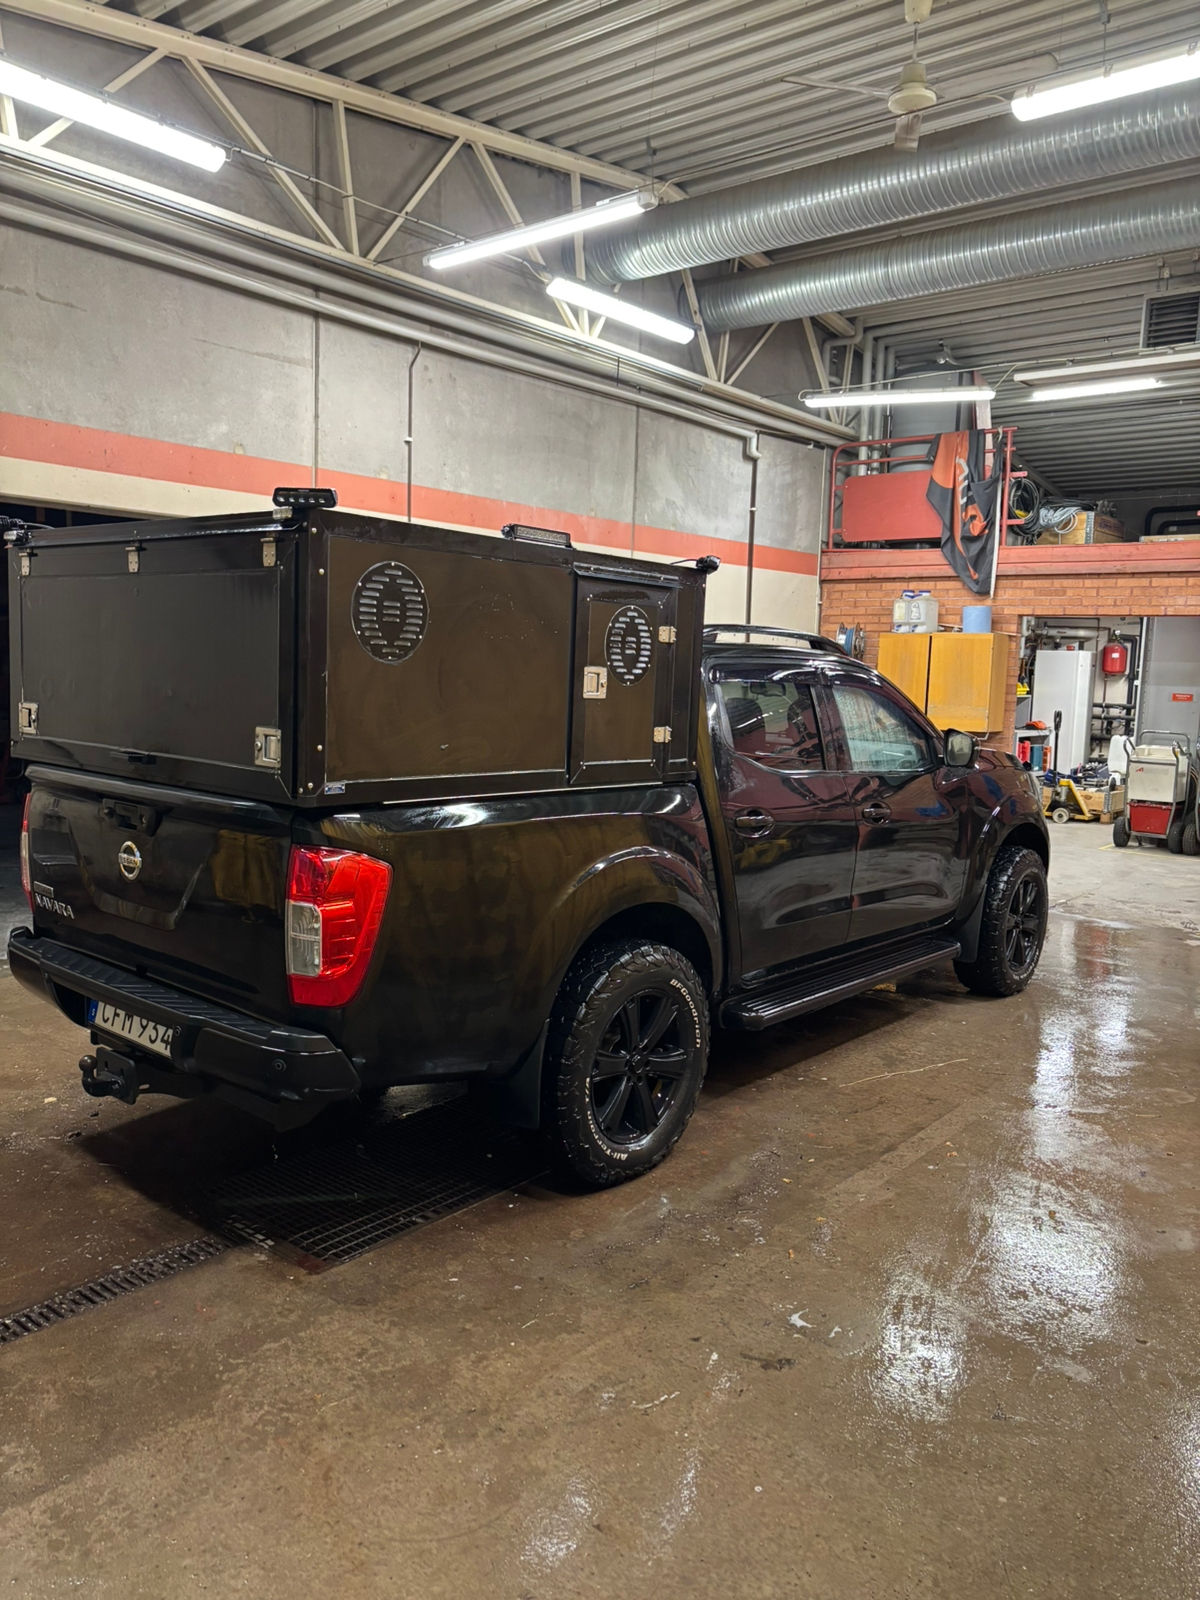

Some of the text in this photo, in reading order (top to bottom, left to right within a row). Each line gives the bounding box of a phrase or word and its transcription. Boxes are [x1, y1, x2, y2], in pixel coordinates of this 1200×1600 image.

[35, 893, 74, 919] NAVARA
[102, 1003, 171, 1050] CFM 934
[670, 978, 701, 1048] BFGoodrich
